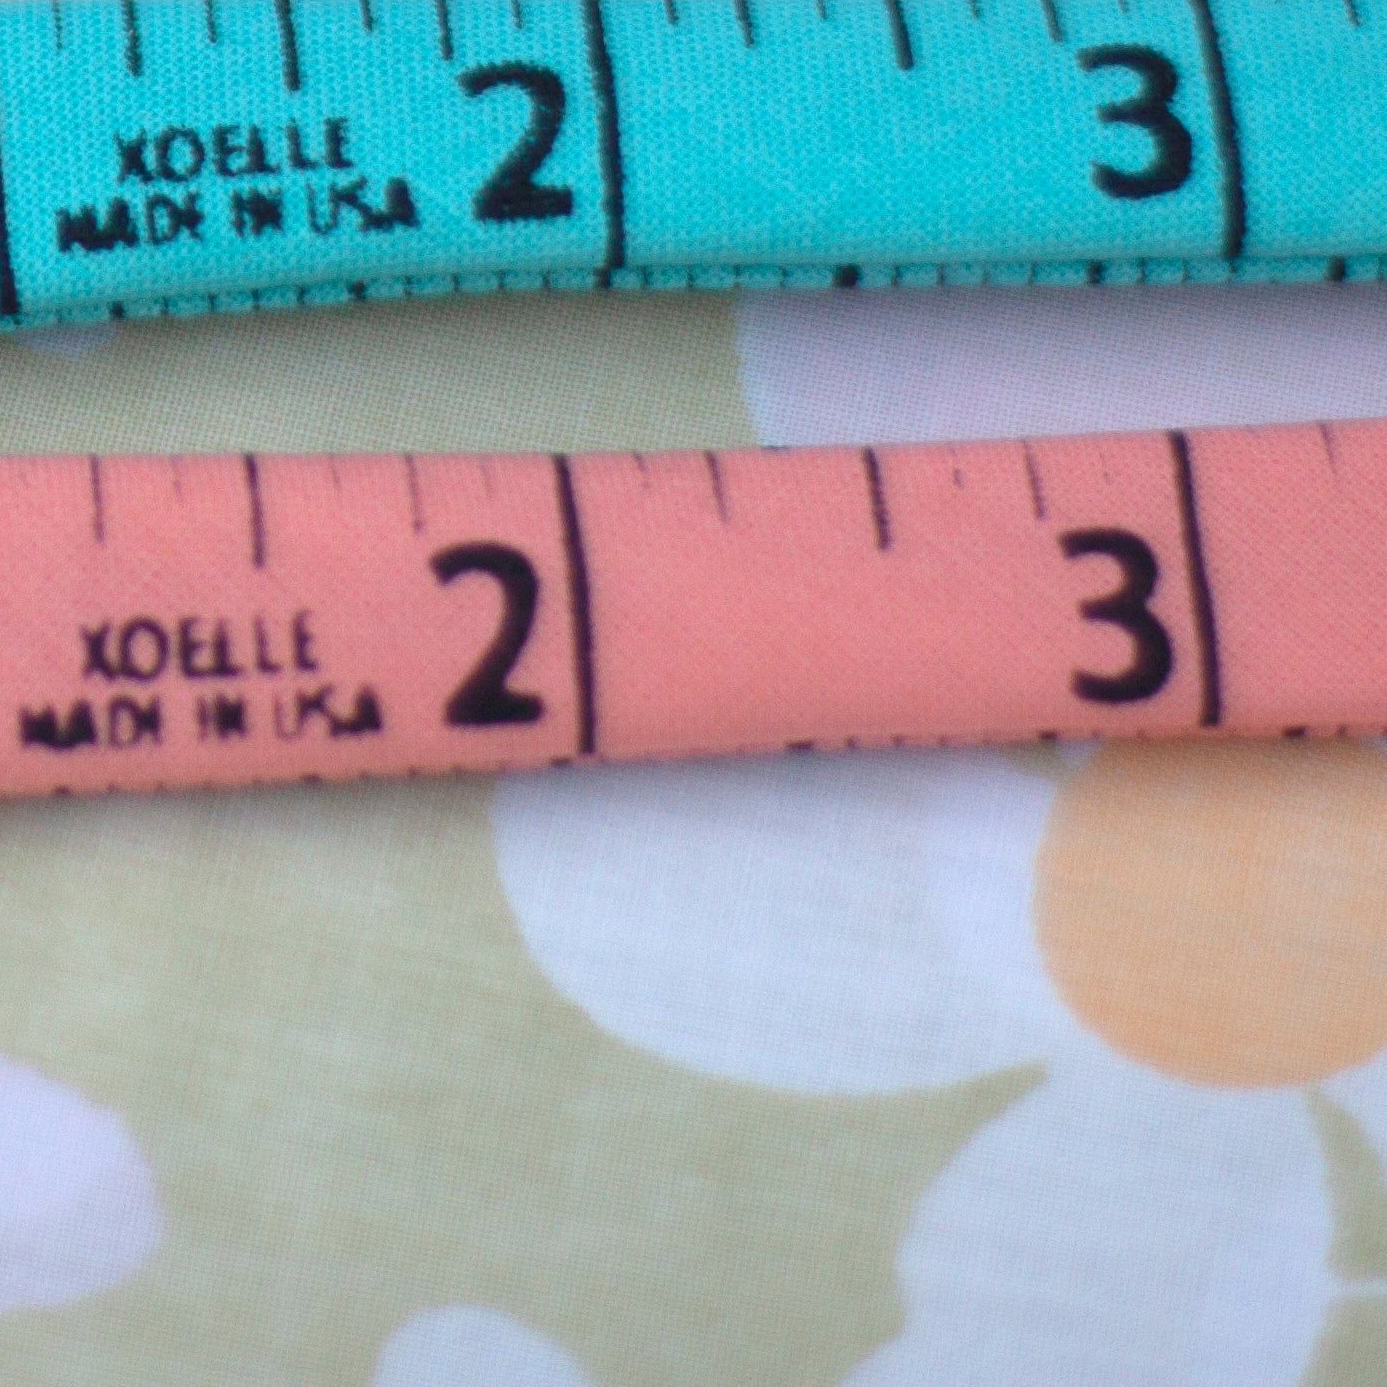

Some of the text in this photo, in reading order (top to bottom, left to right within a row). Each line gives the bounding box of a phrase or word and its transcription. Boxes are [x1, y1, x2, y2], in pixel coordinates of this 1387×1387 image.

[116, 117, 352, 183] XOELLE
[456, 61, 574, 222] 2
[1077, 43, 1192, 199] 3
[80, 609, 318, 681] XOELLE
[430, 541, 545, 727] 2
[1059, 527, 1175, 703] 3
[199, 696, 246, 738] IN
